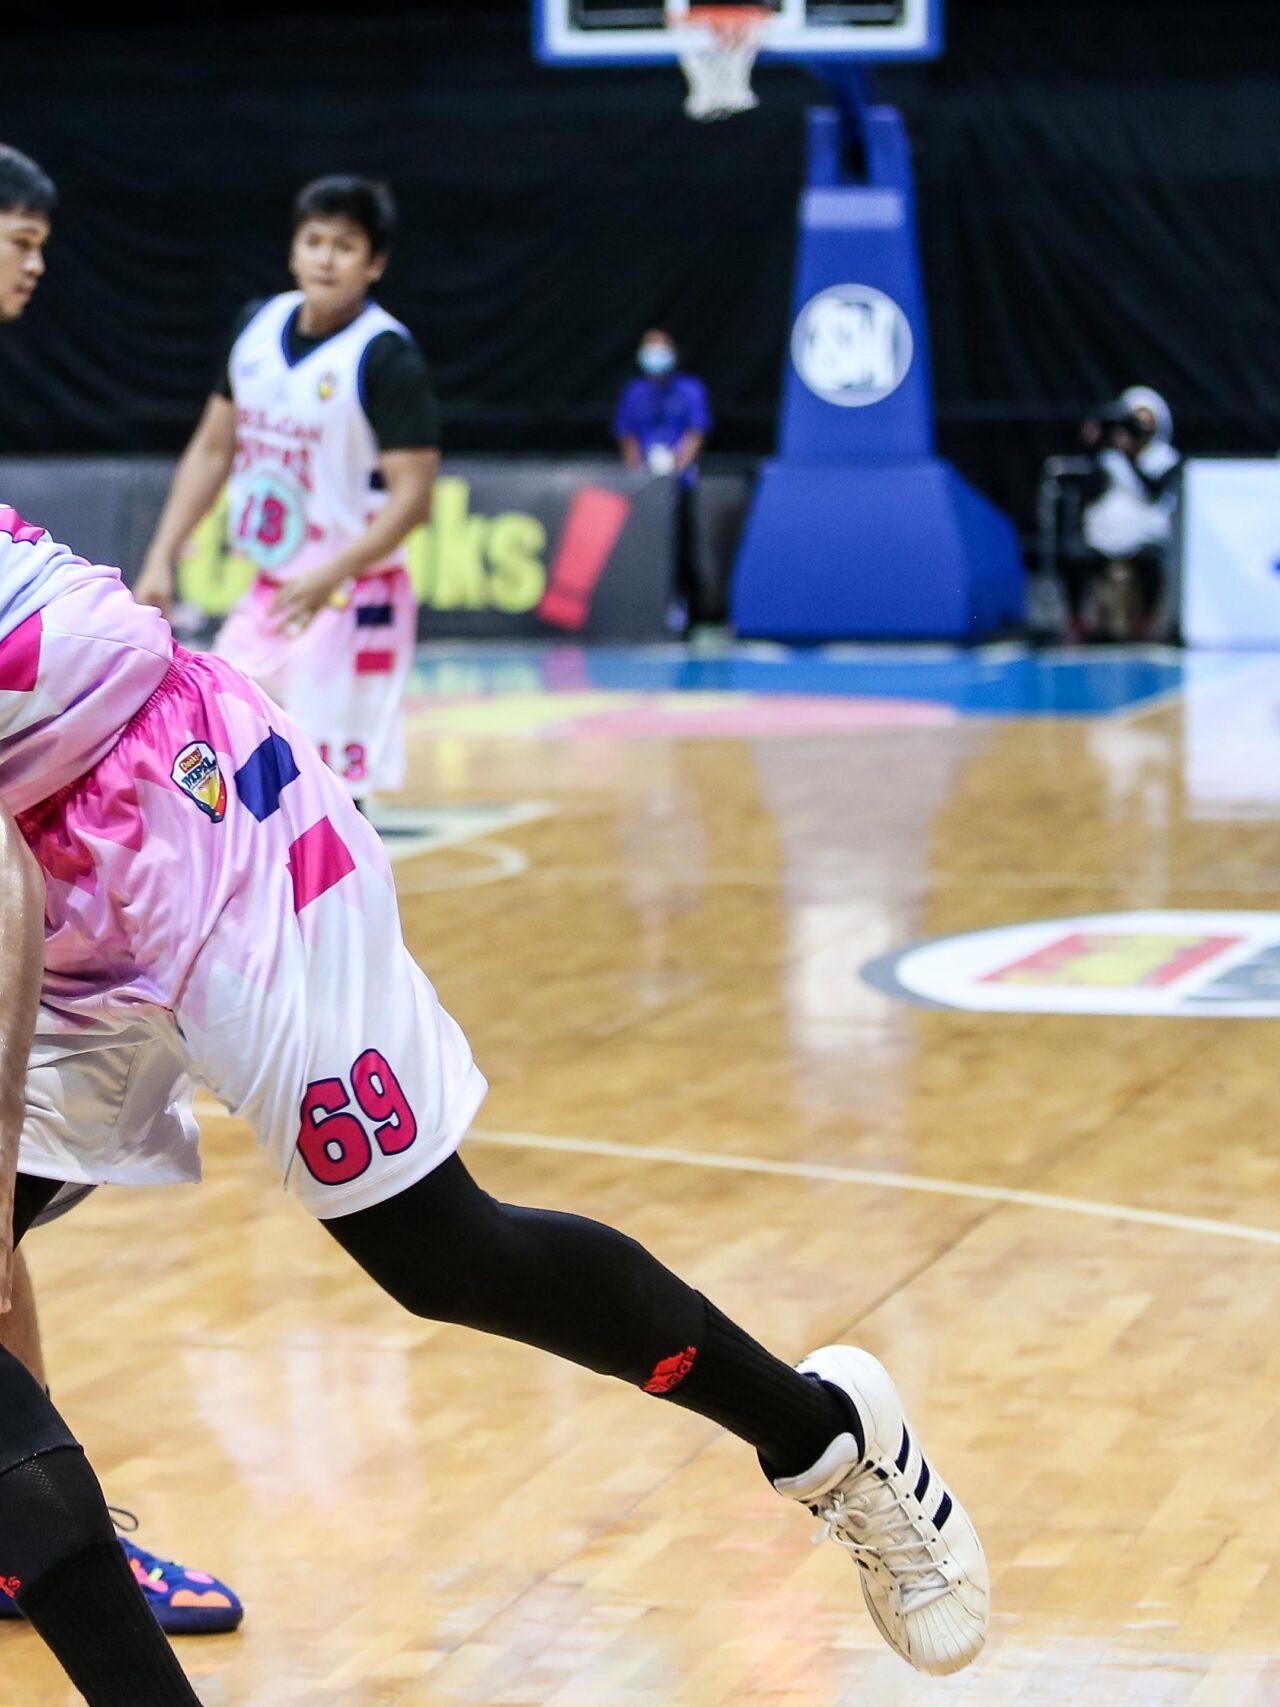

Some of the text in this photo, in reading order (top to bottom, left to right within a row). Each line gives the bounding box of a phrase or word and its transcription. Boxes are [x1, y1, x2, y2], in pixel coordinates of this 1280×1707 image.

[236, 494, 288, 546] 13
[318, 742, 369, 782] 13
[297, 1048, 418, 1186] 69
